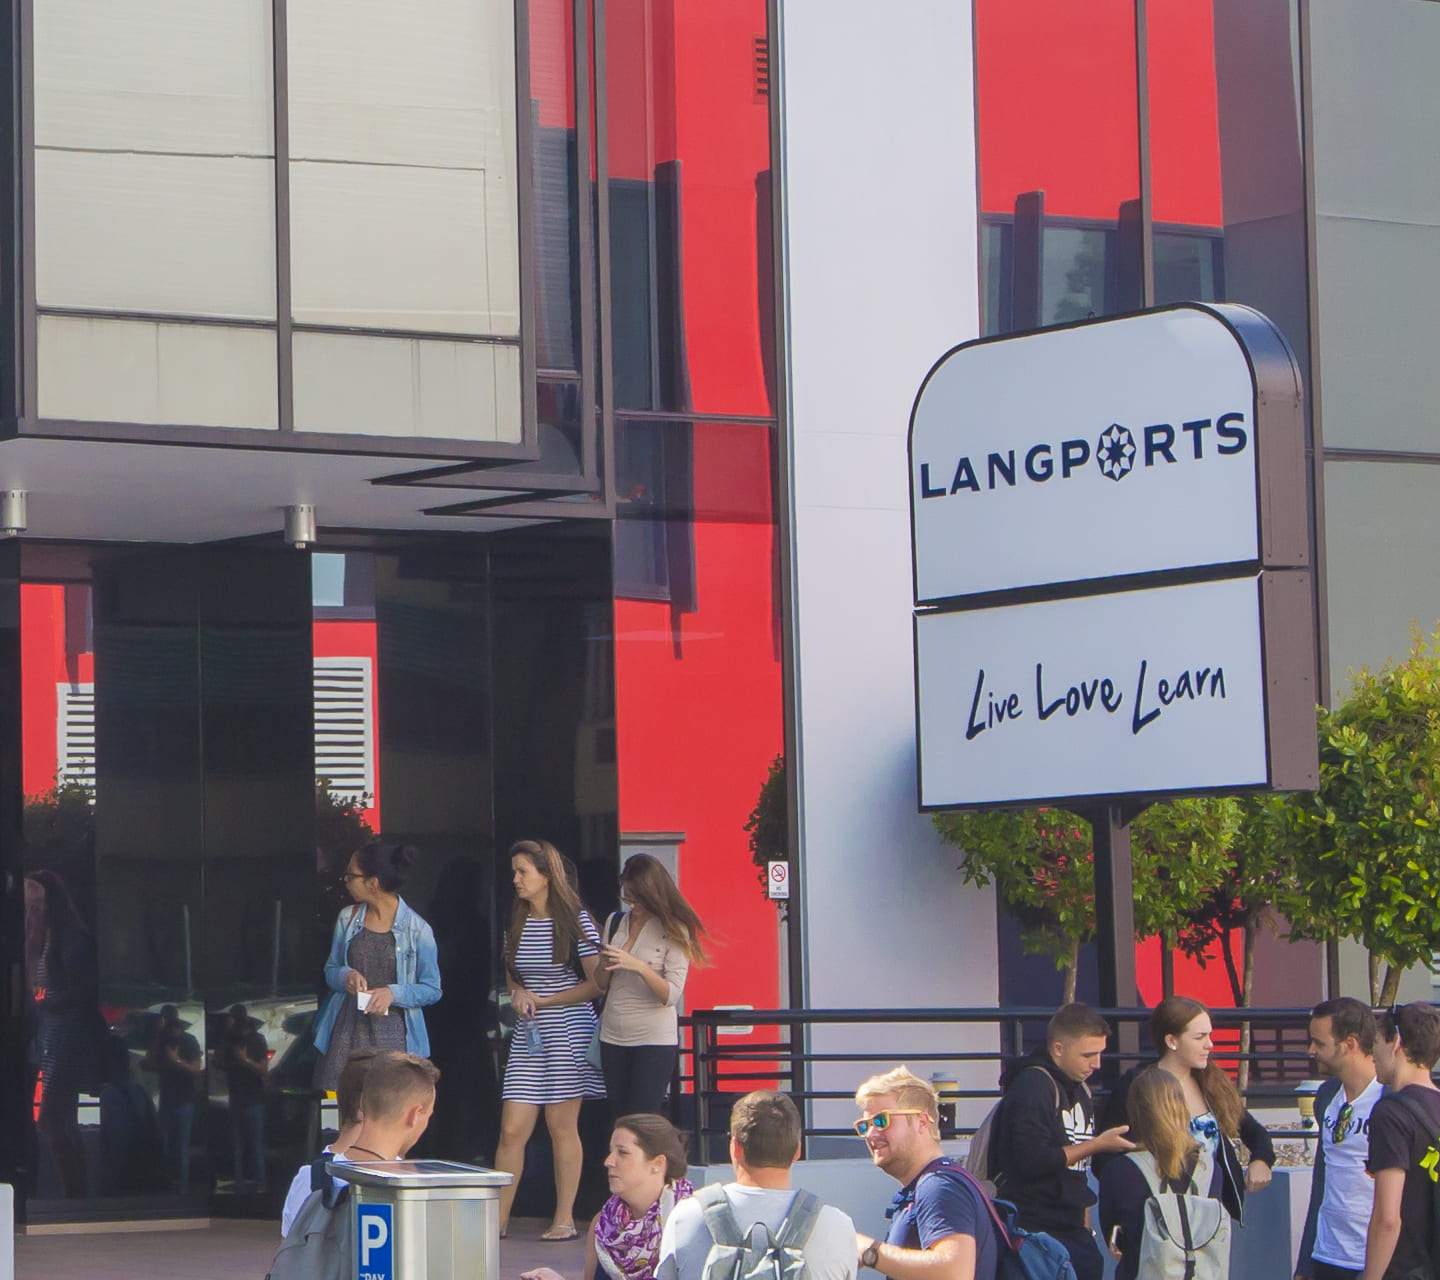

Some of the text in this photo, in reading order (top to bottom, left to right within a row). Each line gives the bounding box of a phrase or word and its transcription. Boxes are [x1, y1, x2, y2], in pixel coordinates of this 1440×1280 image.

[919, 411, 1248, 500] LANGPORTS
[965, 659, 1227, 740] Live Love Learn
[361, 1214, 388, 1266] P
